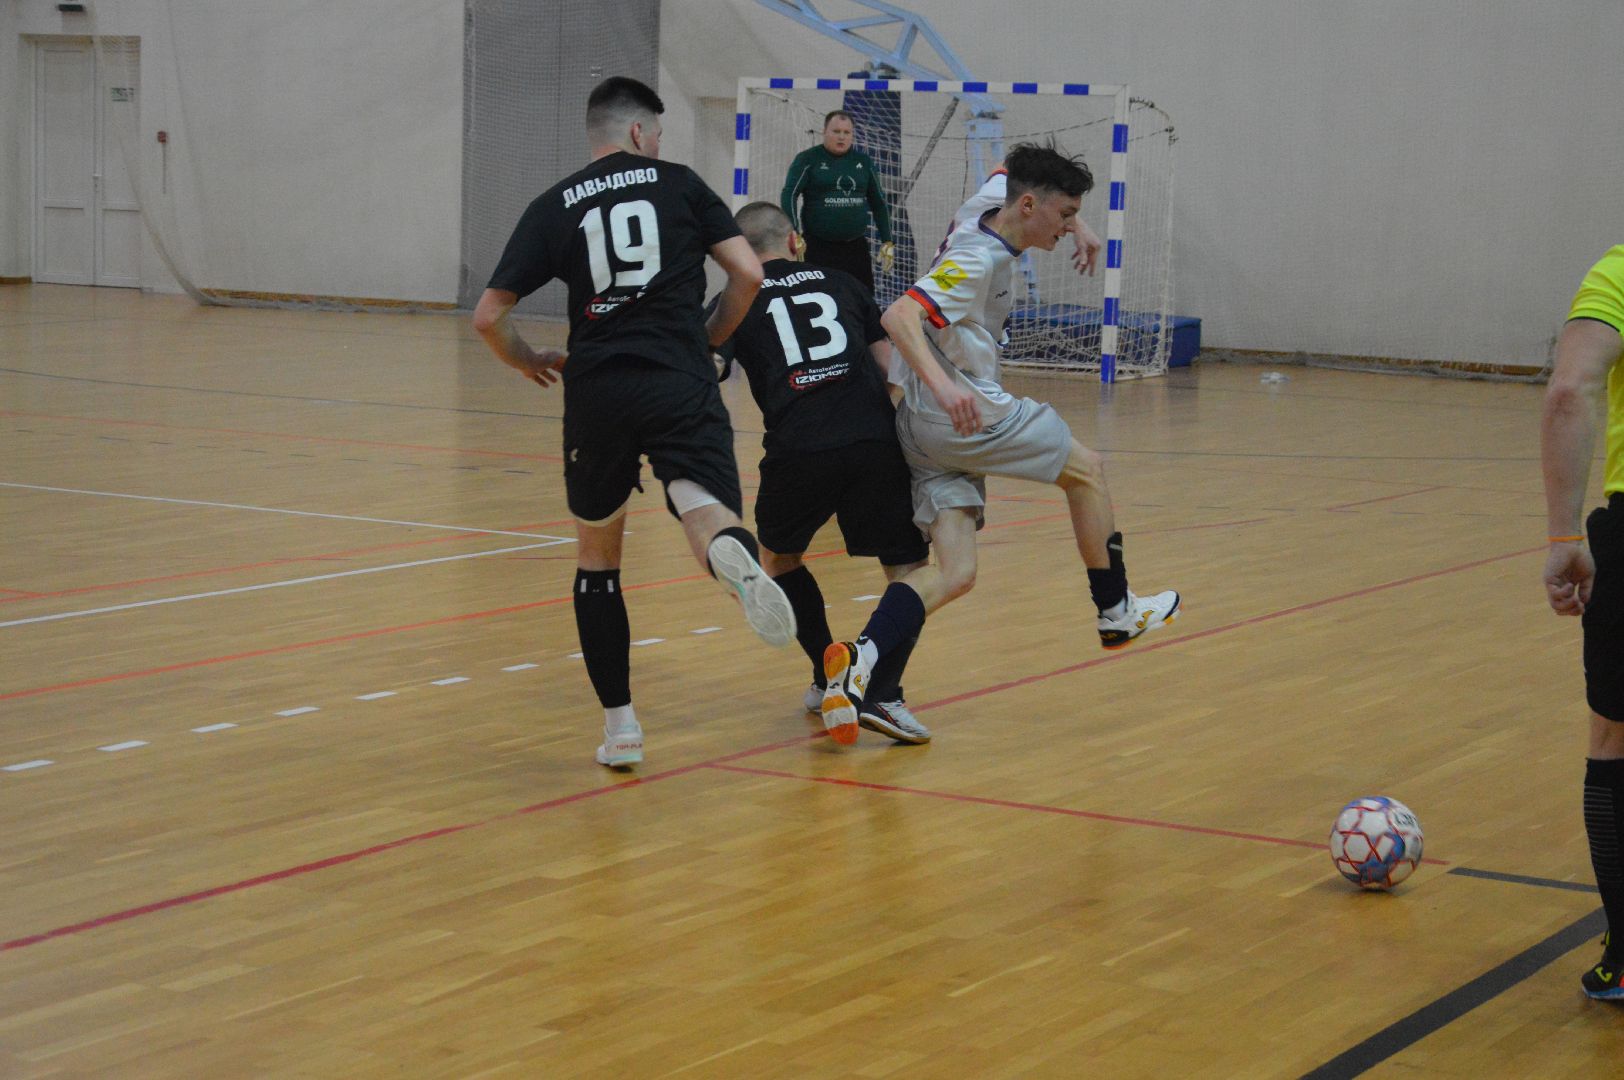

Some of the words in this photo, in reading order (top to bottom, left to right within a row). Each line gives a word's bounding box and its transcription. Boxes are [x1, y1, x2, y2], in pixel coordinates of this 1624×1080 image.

[562, 167, 658, 208] ДАВЫДОВО
[578, 199, 661, 294] 19
[766, 291, 848, 366] 13
